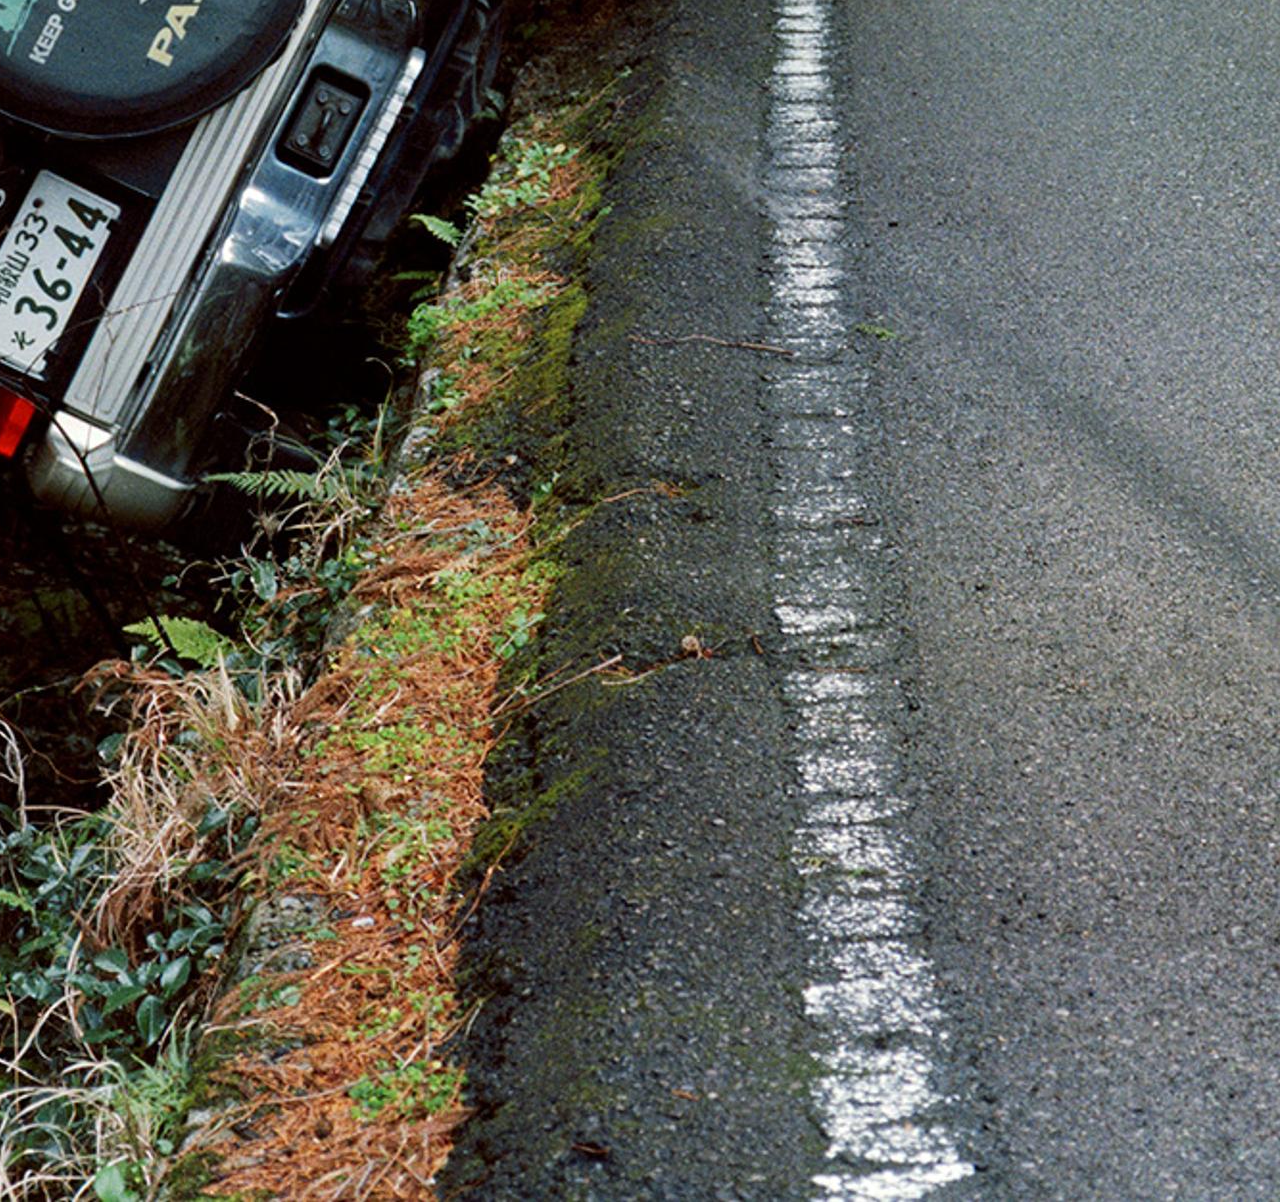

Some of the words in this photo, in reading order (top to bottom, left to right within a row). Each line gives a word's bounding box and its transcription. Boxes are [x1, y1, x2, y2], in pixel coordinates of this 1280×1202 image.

[28, 15, 64, 65] KEEP
[14, 212, 48, 252] 33
[14, 197, 108, 331] 36-44
